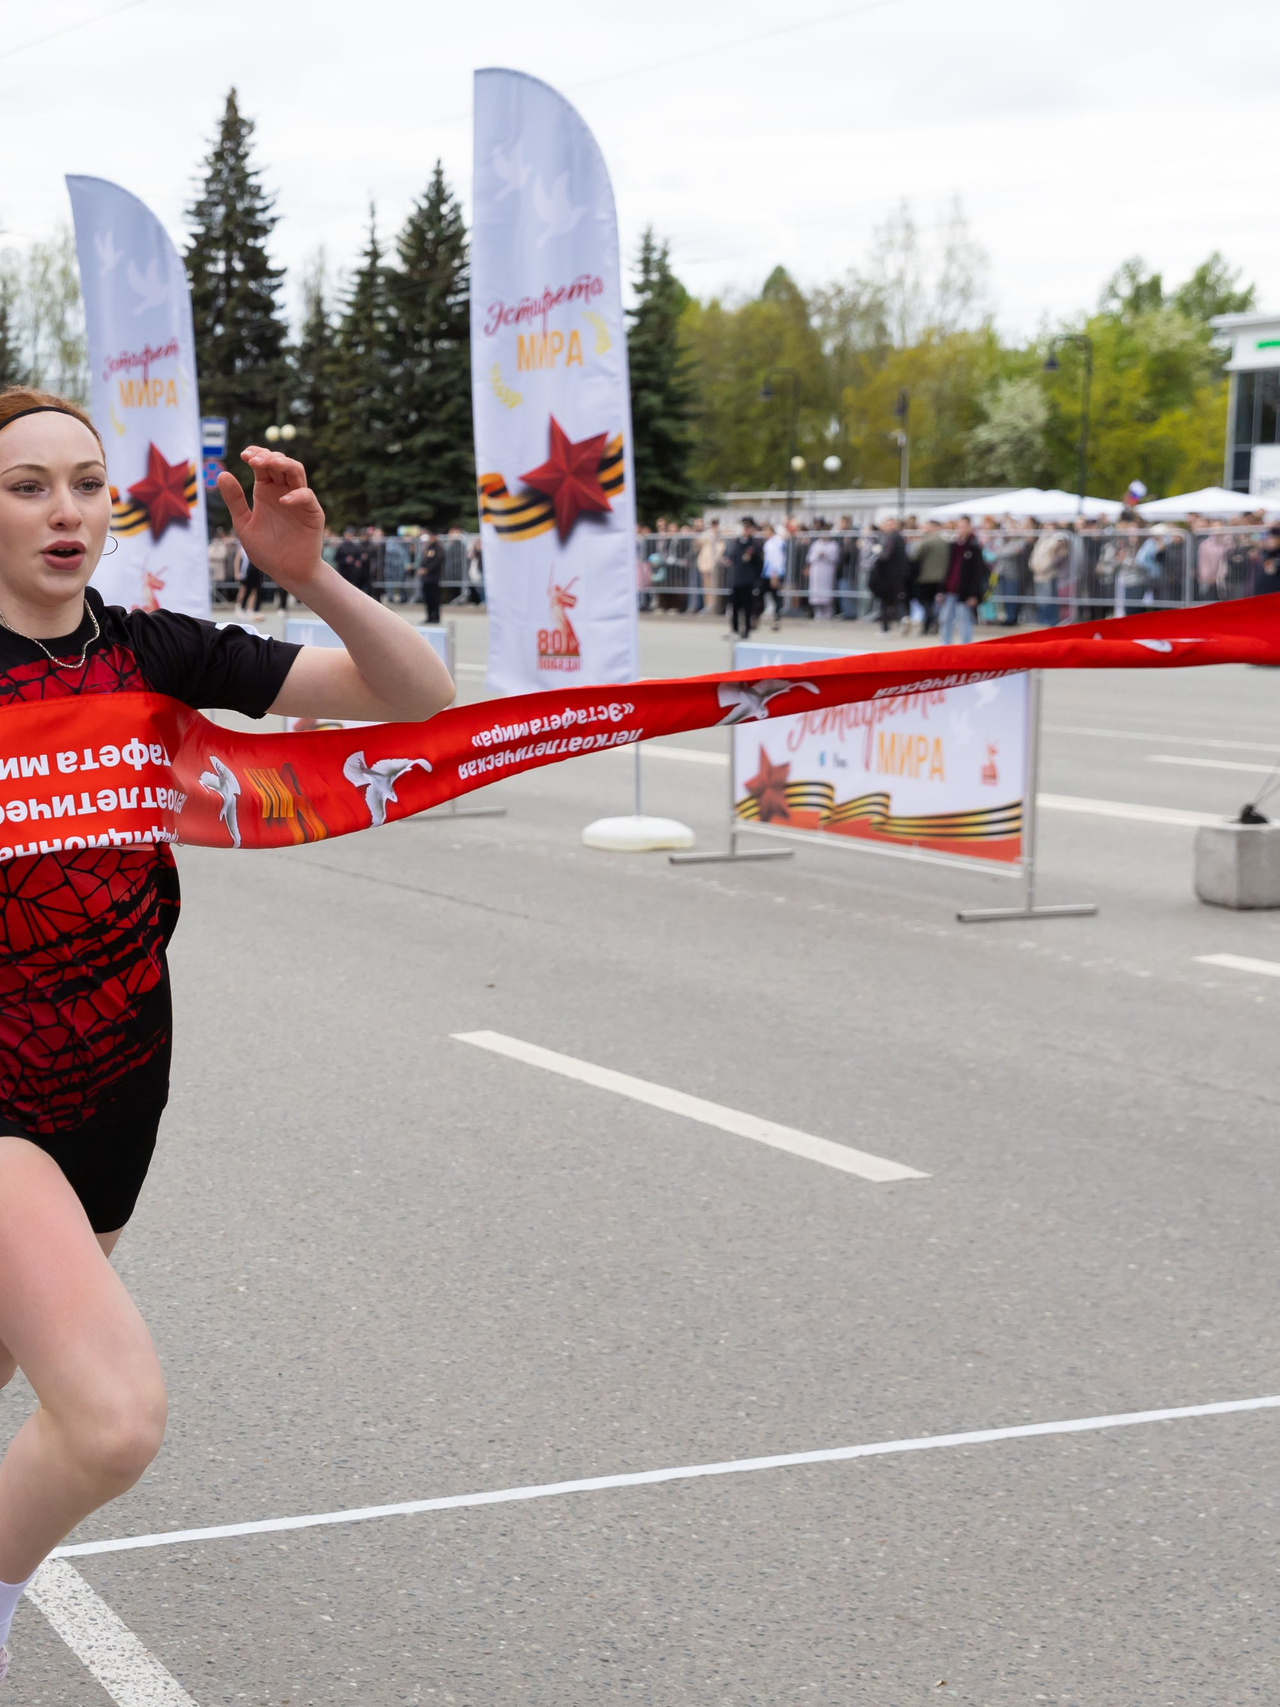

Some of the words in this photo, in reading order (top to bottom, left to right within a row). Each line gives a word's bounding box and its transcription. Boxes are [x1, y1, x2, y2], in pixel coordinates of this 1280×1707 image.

[517, 329, 583, 372] МИРА
[119, 379, 179, 408] МИРА
[537, 629, 562, 654] 80
[56, 738, 171, 774] тафета
[458, 728, 644, 780] легкоатлетическая
[877, 731, 946, 783] МИРА
